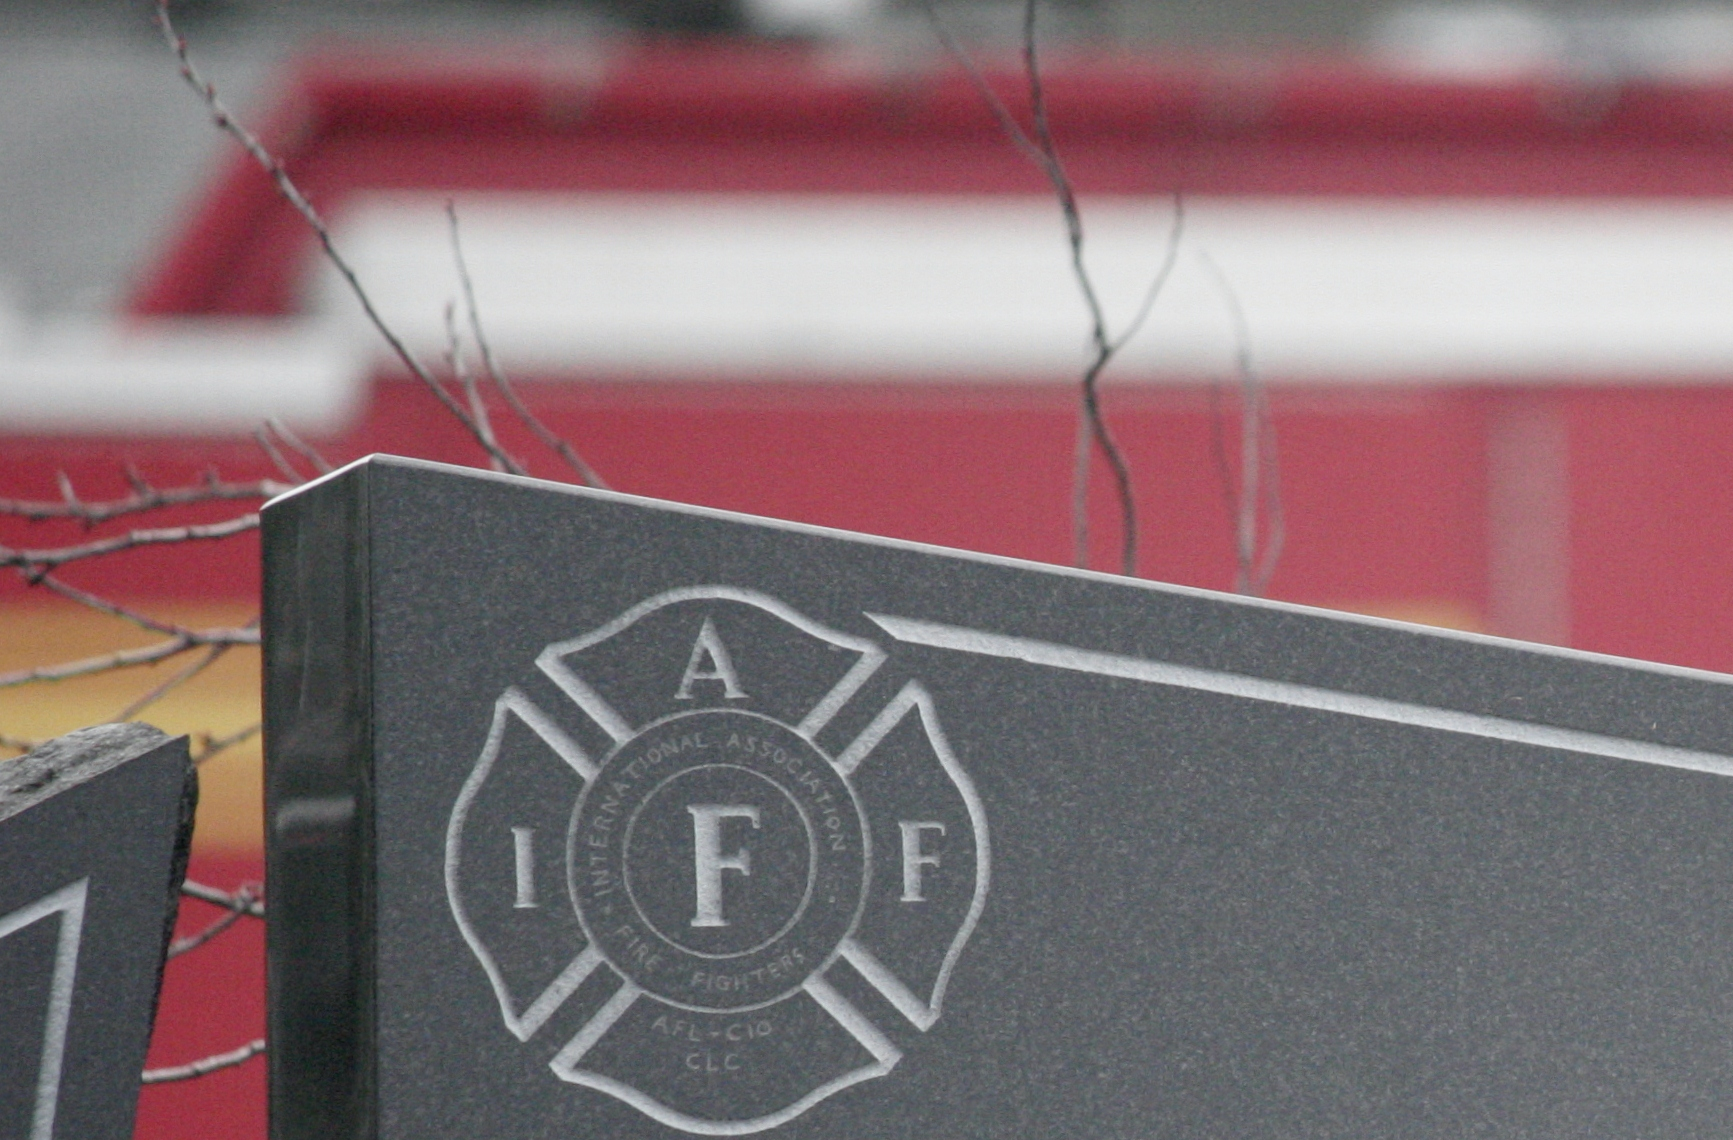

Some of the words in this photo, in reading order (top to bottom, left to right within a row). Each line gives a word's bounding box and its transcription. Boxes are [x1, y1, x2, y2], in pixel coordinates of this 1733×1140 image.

[674, 617, 748, 700] A
[588, 732, 709, 897] INTERNATIONAL
[726, 732, 847, 852] ASSOCIATION
[510, 826, 538, 909] I
[686, 804, 761, 928] F
[898, 820, 947, 903] F
[614, 925, 663, 972] FIRE
[690, 948, 805, 992] FIGHTERS
[652, 1015, 772, 1042] AFL-CIO
[685, 1053, 741, 1072] CLC
